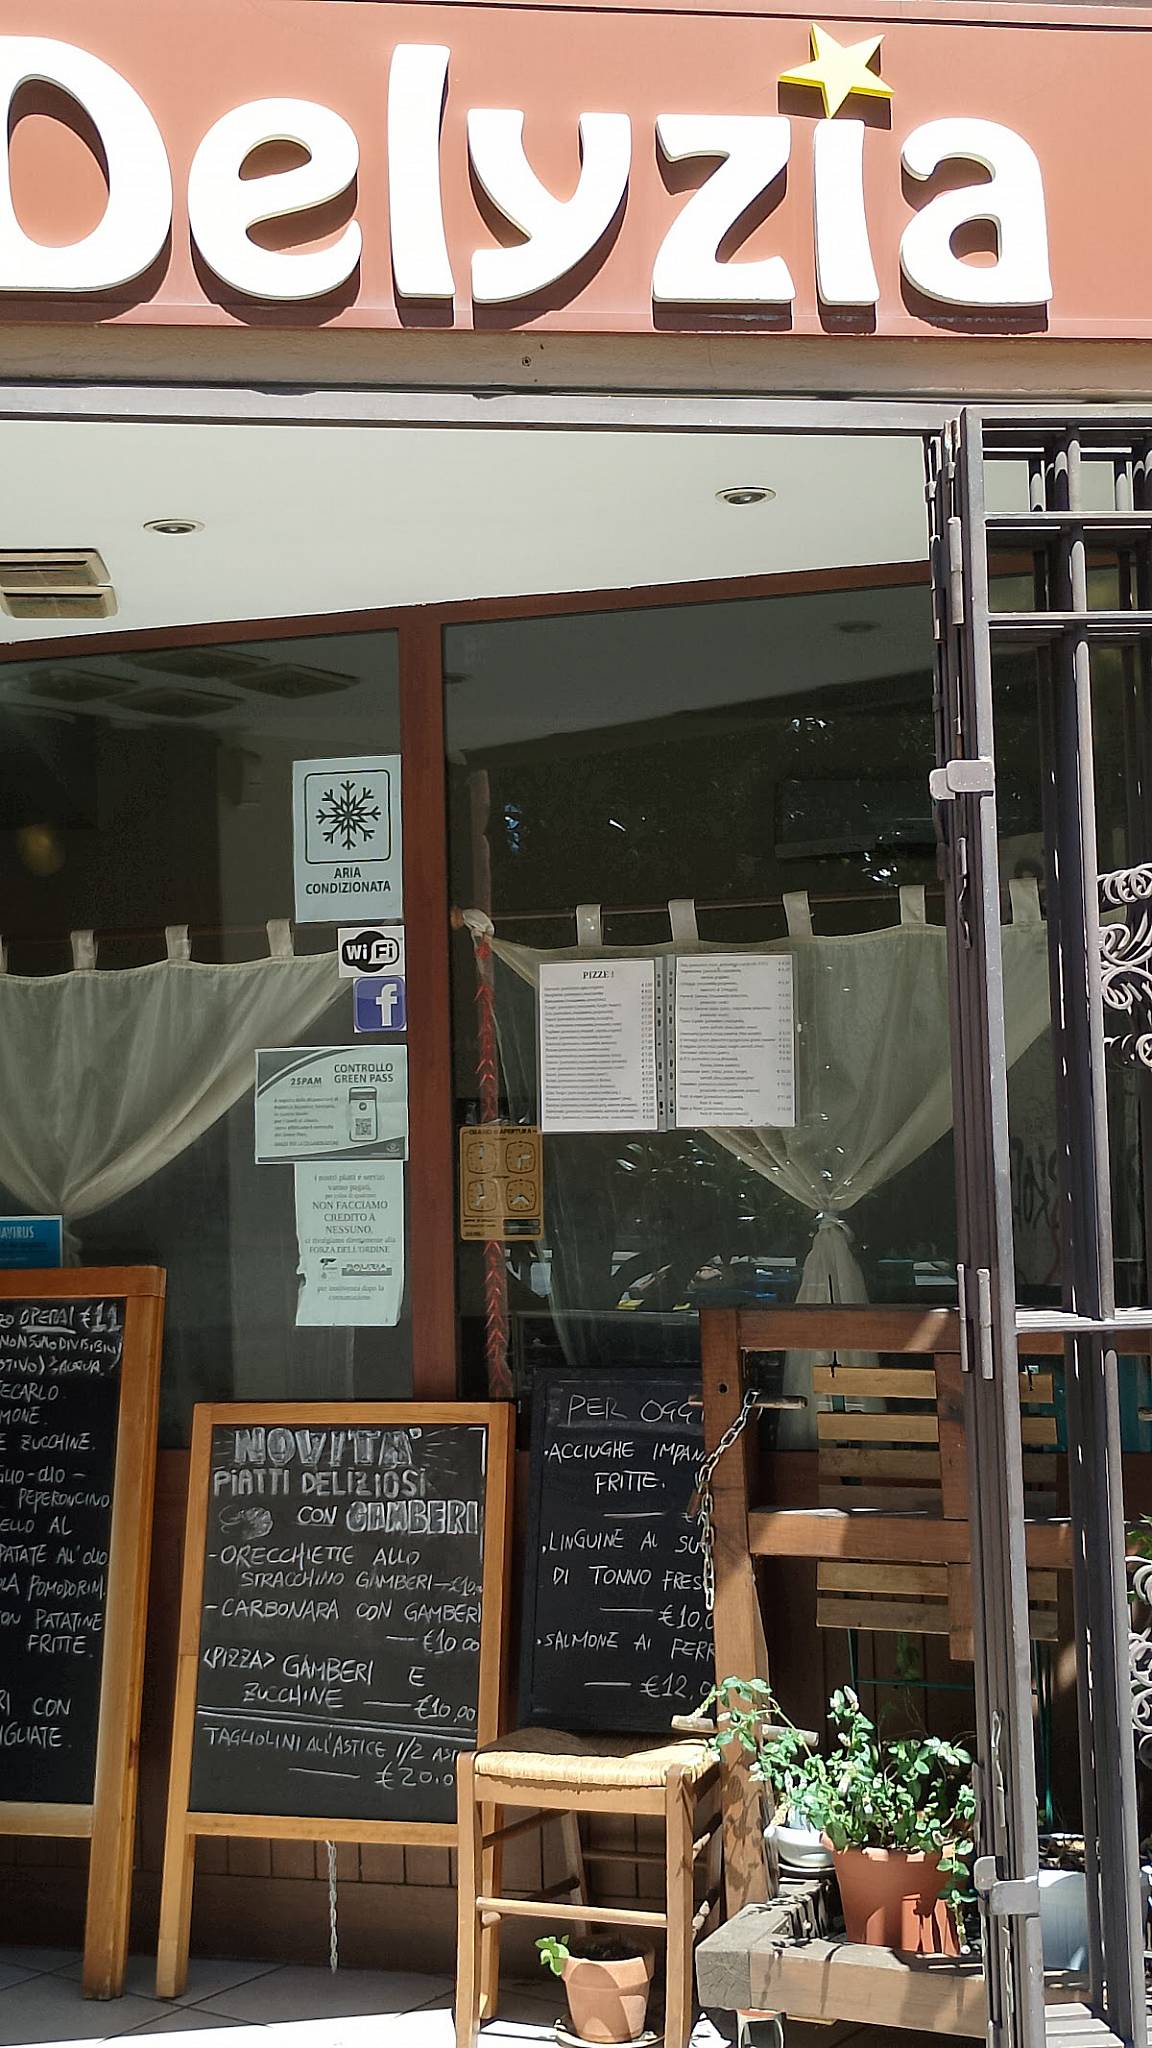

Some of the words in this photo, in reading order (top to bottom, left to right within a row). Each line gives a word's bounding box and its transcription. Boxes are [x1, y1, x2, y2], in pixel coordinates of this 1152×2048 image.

[0, 35, 1052, 305] Delyzia
[334, 867, 361, 879] ARIA
[305, 880, 391, 895] CONDIZIONATA
[583, 971, 609, 979] PIZZE
[334, 1063, 393, 1074] CONTROLLO
[334, 1074, 366, 1083] GREEN
[369, 1073, 394, 1083] PASS
[312, 1201, 334, 1210] NON
[336, 1200, 388, 1210] FACCIAMO
[324, 1213, 368, 1222] CREDITO
[368, 1213, 376, 1221] A
[0, 1225, 35, 1239] AVIRUS
[0, 1379, 59, 1402] ECARLO
[567, 1394, 628, 1426] PER
[19, 1487, 110, 1515] PEPERONCINO
[48, 1515, 73, 1536] AL
[297, 1505, 338, 1525] CON
[346, 1500, 479, 1536] GAMBERI
[240, 1568, 345, 1588] STRACCHINO
[355, 1571, 433, 1592] GAMBERI
[552, 1566, 570, 1585] DI
[588, 1565, 652, 1586] TONNO
[0, 1611, 21, 1627] ON
[36, 1609, 103, 1633] PATATINE
[356, 1600, 392, 1621] CON
[404, 1601, 481, 1624] GAMBERI
[282, 1654, 374, 1686] GAMBERI
[408, 1666, 426, 1686] E
[243, 1682, 345, 1709] ZUCCHINE
[33, 1697, 71, 1717] CON
[202, 1723, 301, 1752] TAGLIOLINI
